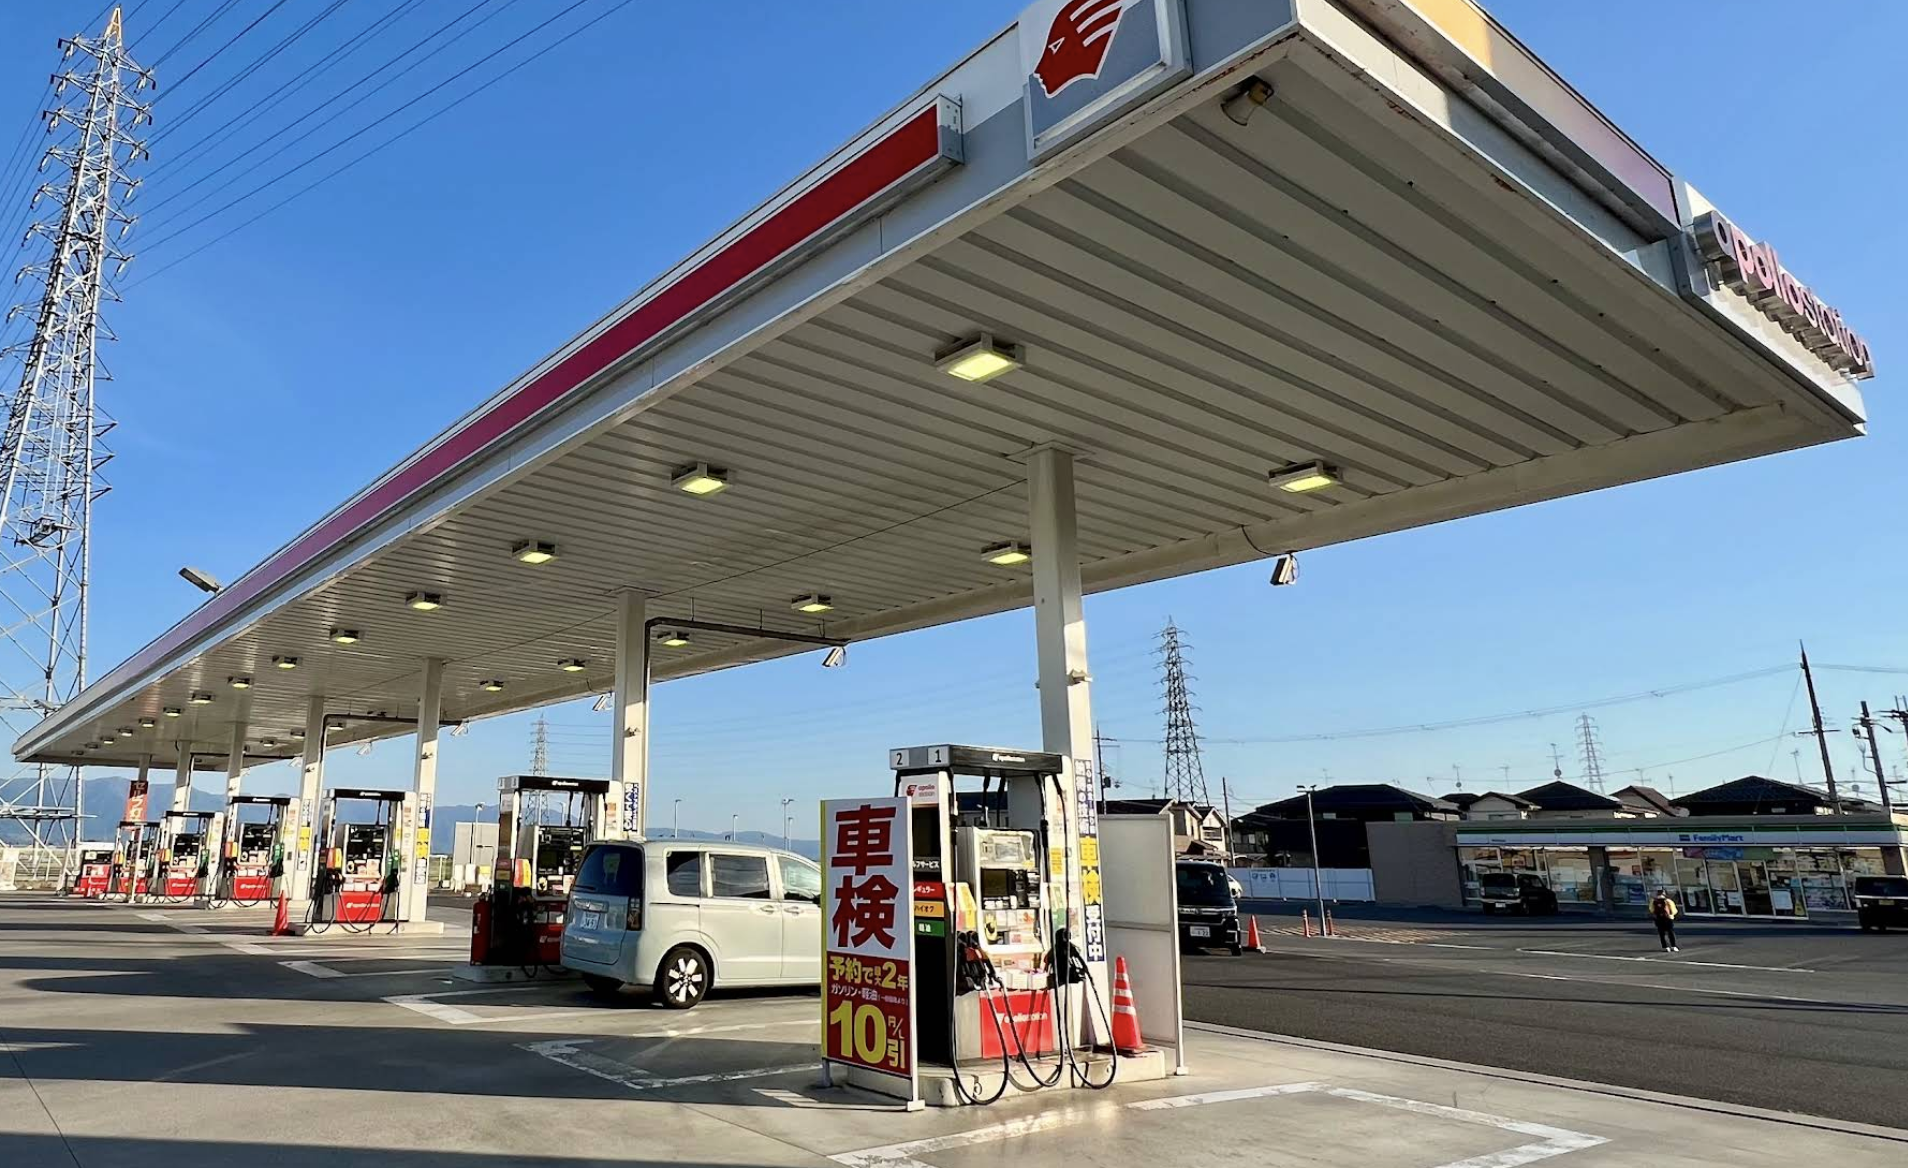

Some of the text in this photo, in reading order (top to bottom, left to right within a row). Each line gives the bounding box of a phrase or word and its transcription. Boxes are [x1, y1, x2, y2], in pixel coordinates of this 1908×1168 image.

[896, 752, 903, 766] 2
[935, 749, 942, 763] 1
[1693, 834, 1744, 842] FamilyMart
[831, 804, 899, 950] 車検
[1080, 835, 1105, 960] 車検受付中
